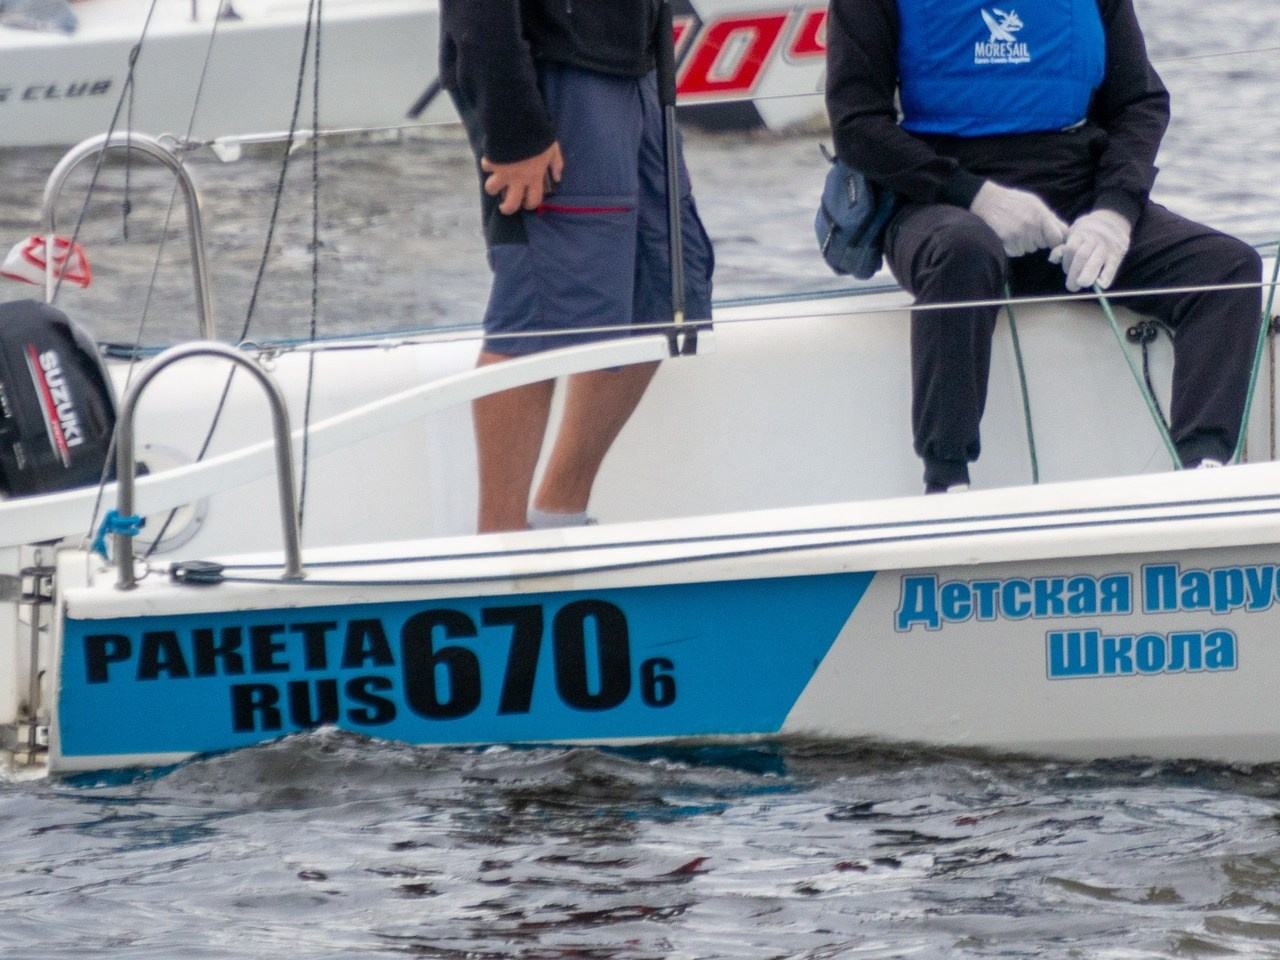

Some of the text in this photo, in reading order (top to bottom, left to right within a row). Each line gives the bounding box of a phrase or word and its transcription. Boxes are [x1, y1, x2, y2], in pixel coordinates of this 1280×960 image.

[974, 41, 1030, 57] MORESAIL
[22, 79, 112, 101] CLUB
[39, 350, 84, 448] SUZUKI
[896, 574, 1134, 632] Детская
[401, 598, 677, 722] 670 6
[1046, 629, 1238, 680] Школа
[230, 675, 397, 734] RUS
